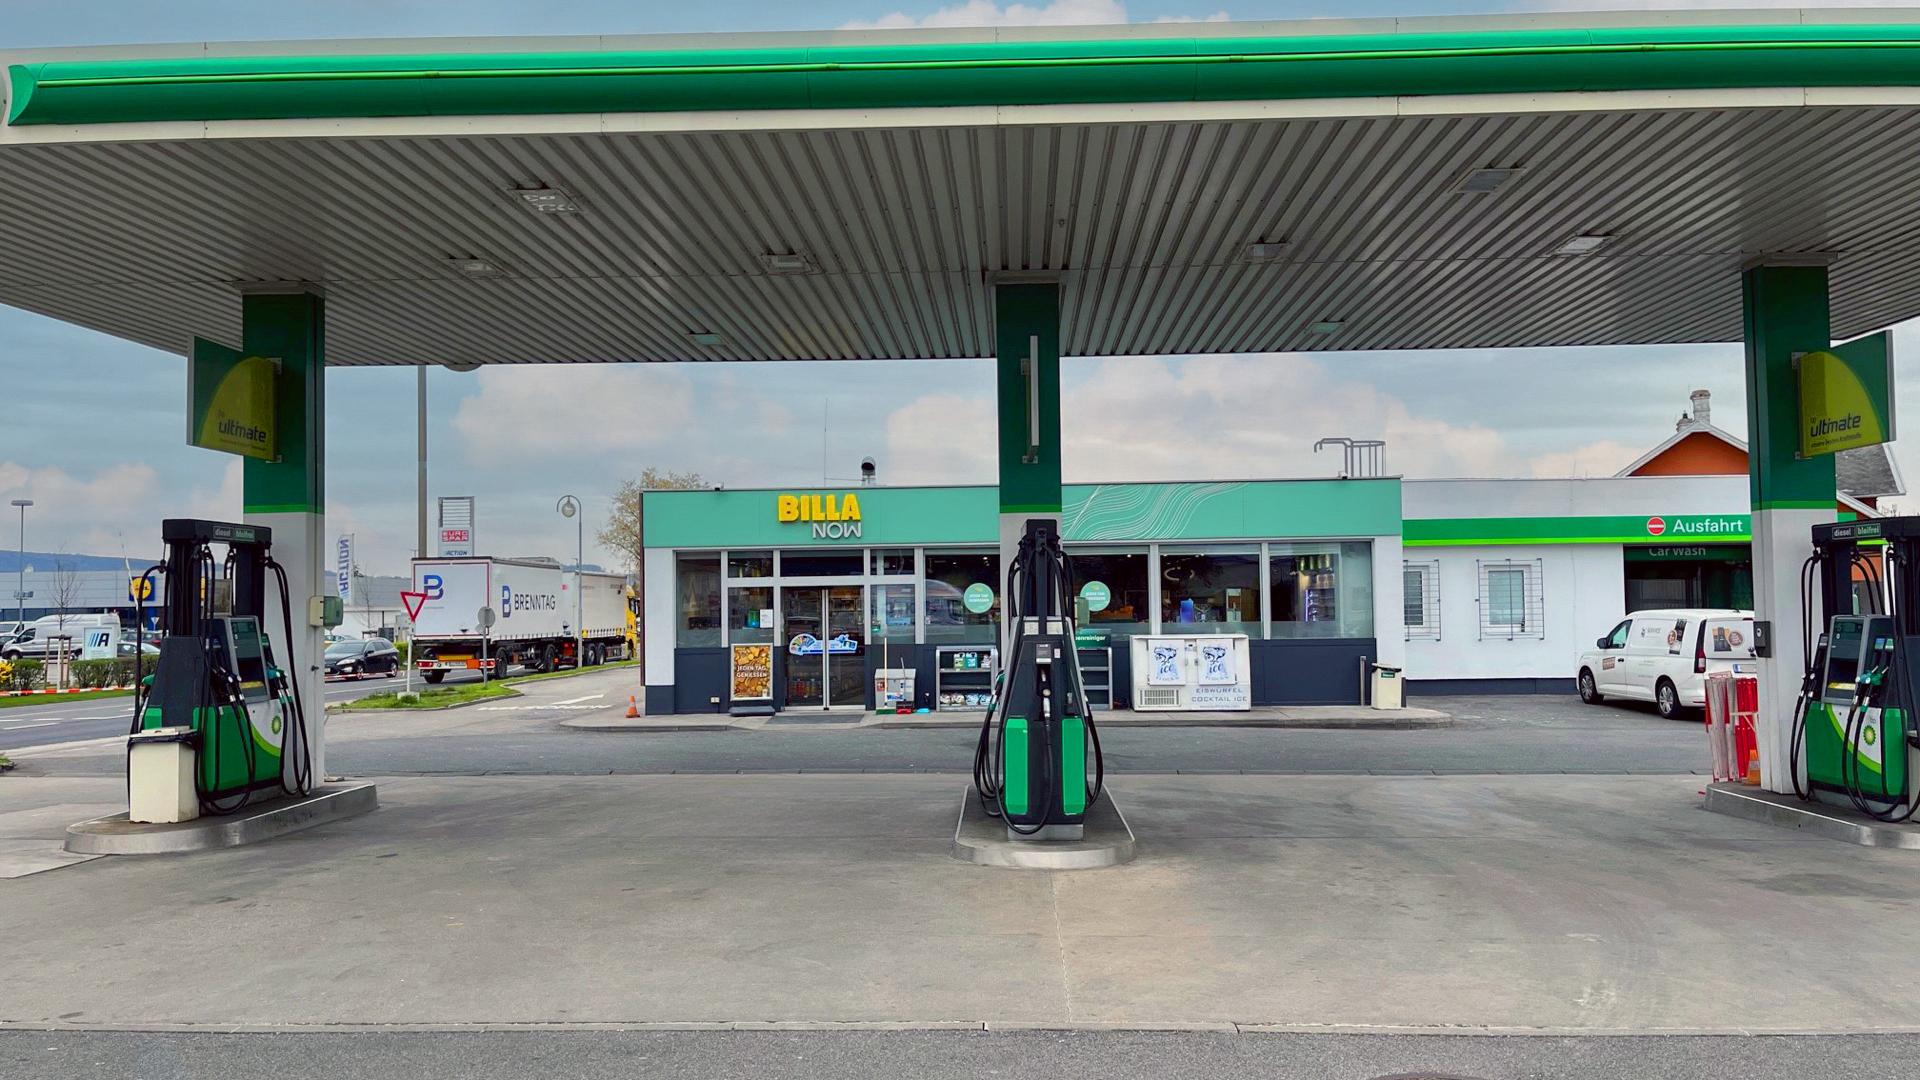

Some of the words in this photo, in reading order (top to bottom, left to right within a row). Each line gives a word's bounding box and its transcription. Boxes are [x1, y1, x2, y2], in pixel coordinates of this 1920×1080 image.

[218, 420, 266, 442] ultimate
[1810, 412, 1861, 437] ultimate
[778, 493, 861, 521] BILLA
[812, 522, 861, 538] NOW
[1672, 519, 1743, 533] Ausfahrt
[1833, 528, 1852, 537] diesel
[1648, 546, 1670, 557] Car
[513, 593, 556, 611] BRENNTAG
